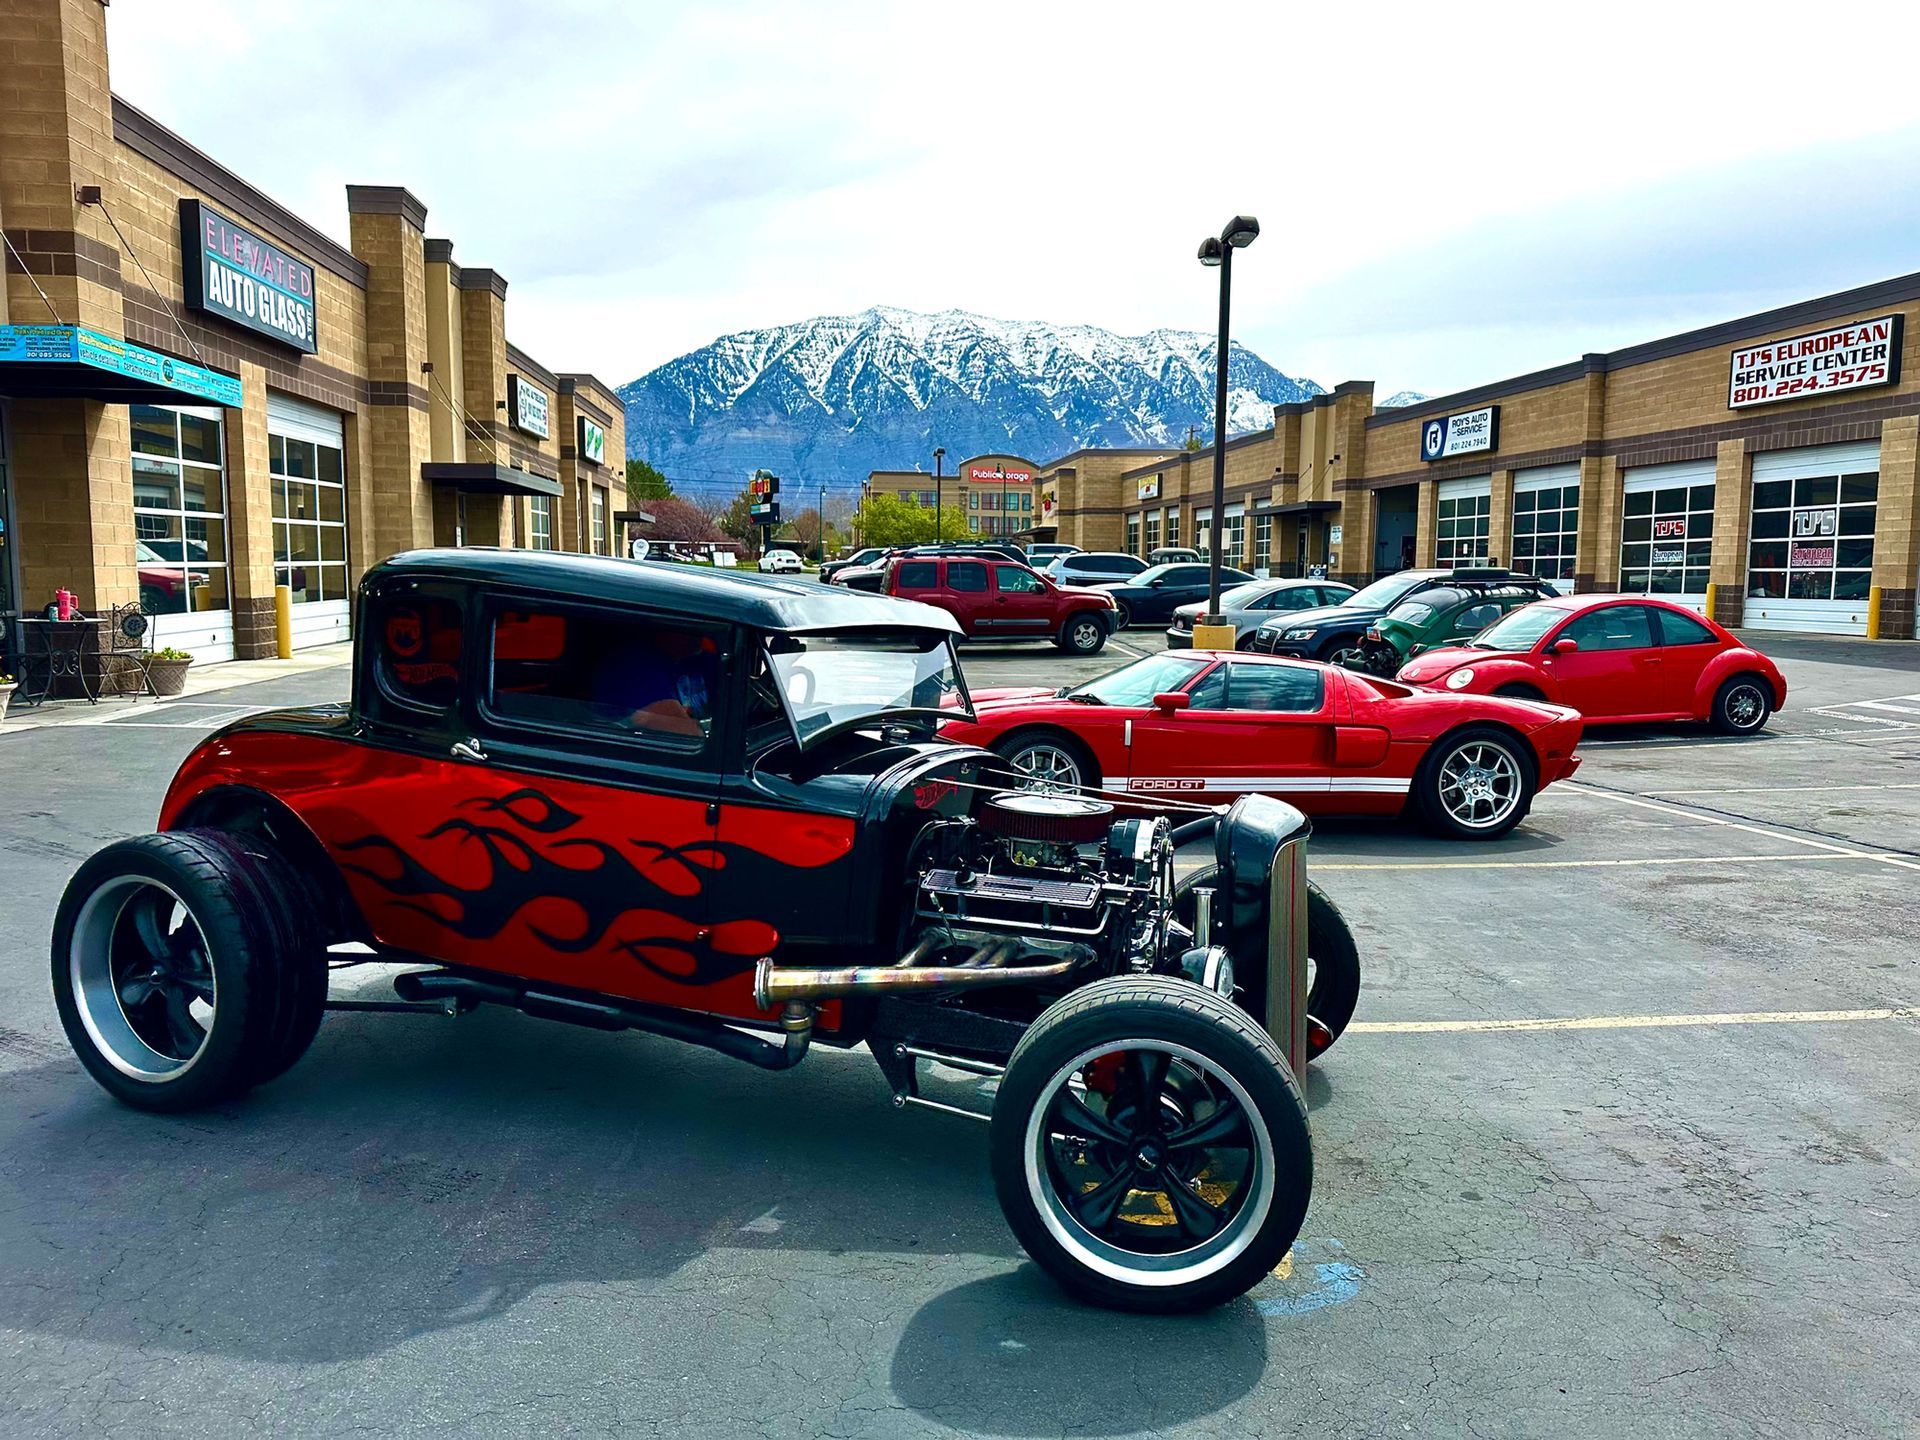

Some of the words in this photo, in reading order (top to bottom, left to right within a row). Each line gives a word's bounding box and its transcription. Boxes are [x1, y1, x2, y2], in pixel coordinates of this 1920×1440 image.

[206, 217, 311, 297] ELEVATED
[209, 260, 255, 318] AUTO
[259, 285, 307, 340] GLASS
[1737, 348, 1772, 369] TJ'S
[1777, 323, 1889, 361] EUROPEAN
[1735, 360, 1807, 387] SERVICE
[1812, 343, 1887, 372] CENTER
[1733, 363, 1886, 404] 801.224.3575
[1452, 417, 1470, 428] ROY'S
[1471, 412, 1488, 424] AUTO
[1457, 423, 1483, 437] SERVICE
[972, 469, 996, 479] Public
[1655, 520, 1685, 536] TJ'S
[1794, 510, 1835, 536] TJ'S
[1131, 780, 1177, 789] FORD
[1179, 780, 1203, 789] GT
